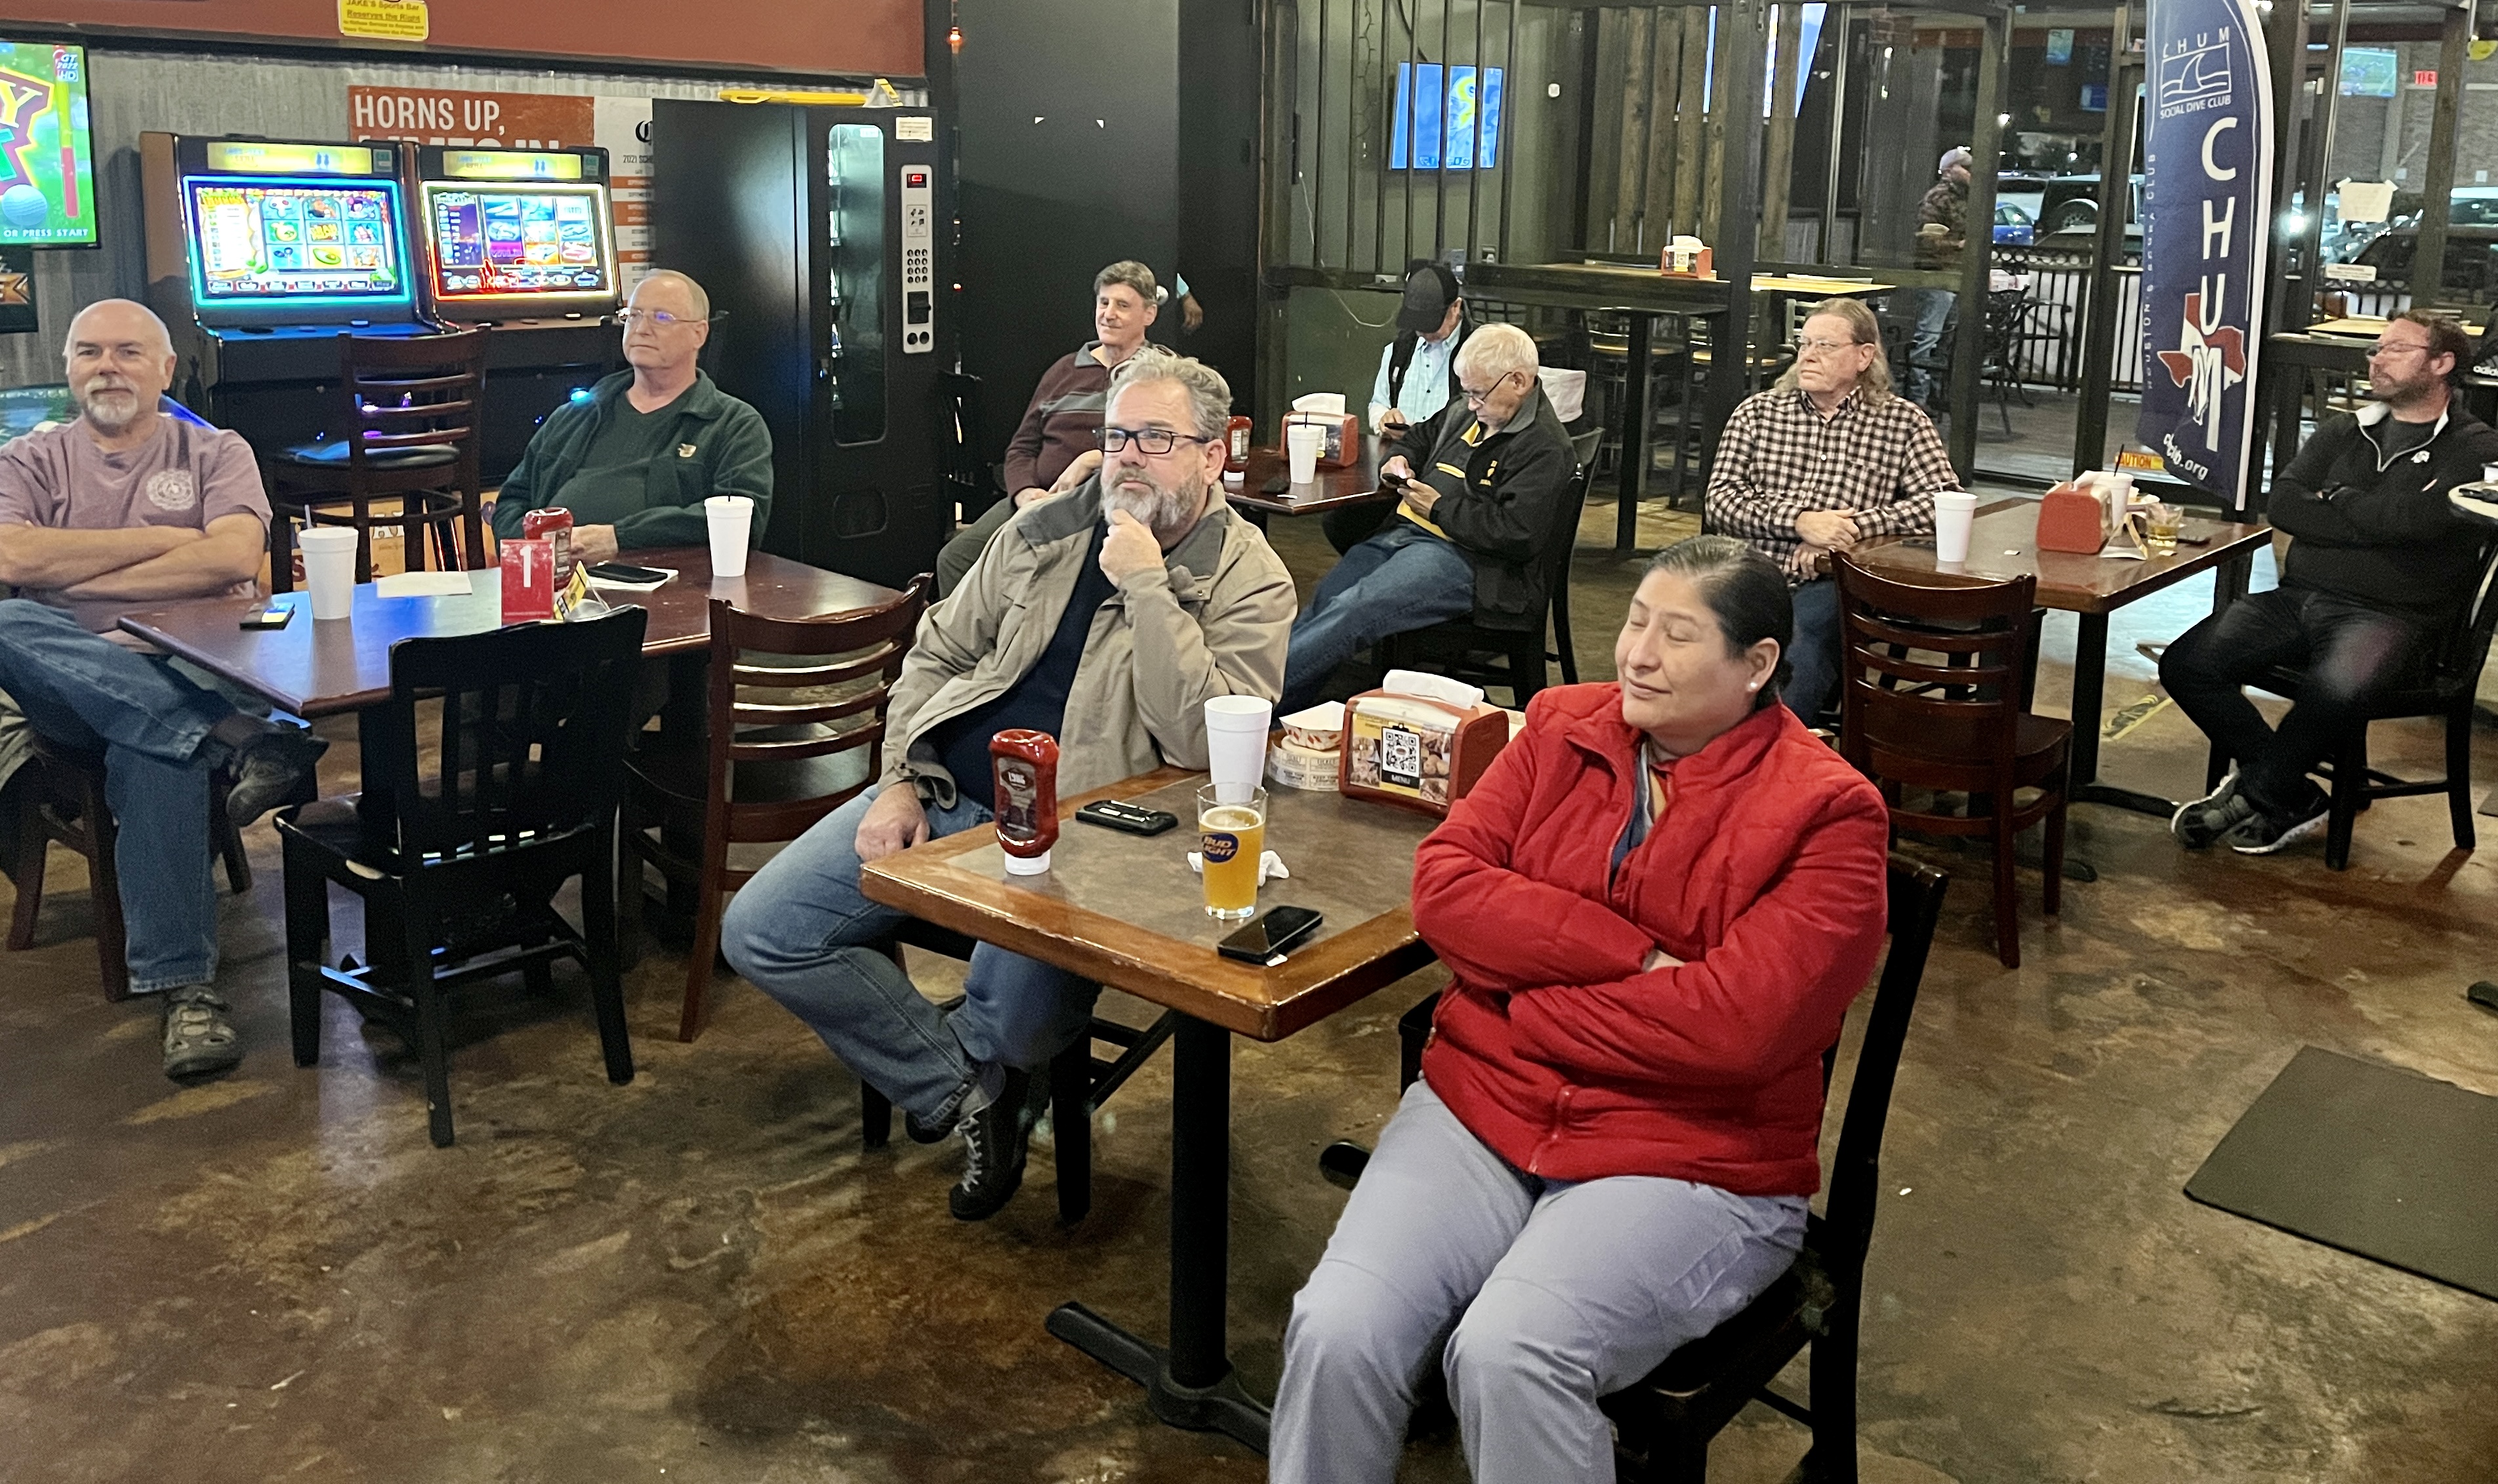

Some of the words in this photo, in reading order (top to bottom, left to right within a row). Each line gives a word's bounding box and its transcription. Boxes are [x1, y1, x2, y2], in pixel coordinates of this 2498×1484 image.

[346, 9, 383, 20] Reserves
[399, 14, 420, 22] Right
[2163, 26, 2229, 58] CHUM
[61, 54, 77, 62] GT
[60, 70, 77, 79] HD
[2160, 105, 2185, 119] SOCIAL
[2186, 99, 2206, 111] DIVE
[2207, 94, 2232, 109] CLUB
[354, 94, 455, 131] HORNS
[464, 99, 505, 136] UP,
[623, 155, 638, 163] 2021
[2146, 153, 2156, 201] CLUB
[56, 228, 89, 237] START
[520, 545, 532, 588] 1
[1391, 773, 1411, 785] MENU
[1203, 835, 1233, 848] BUD
